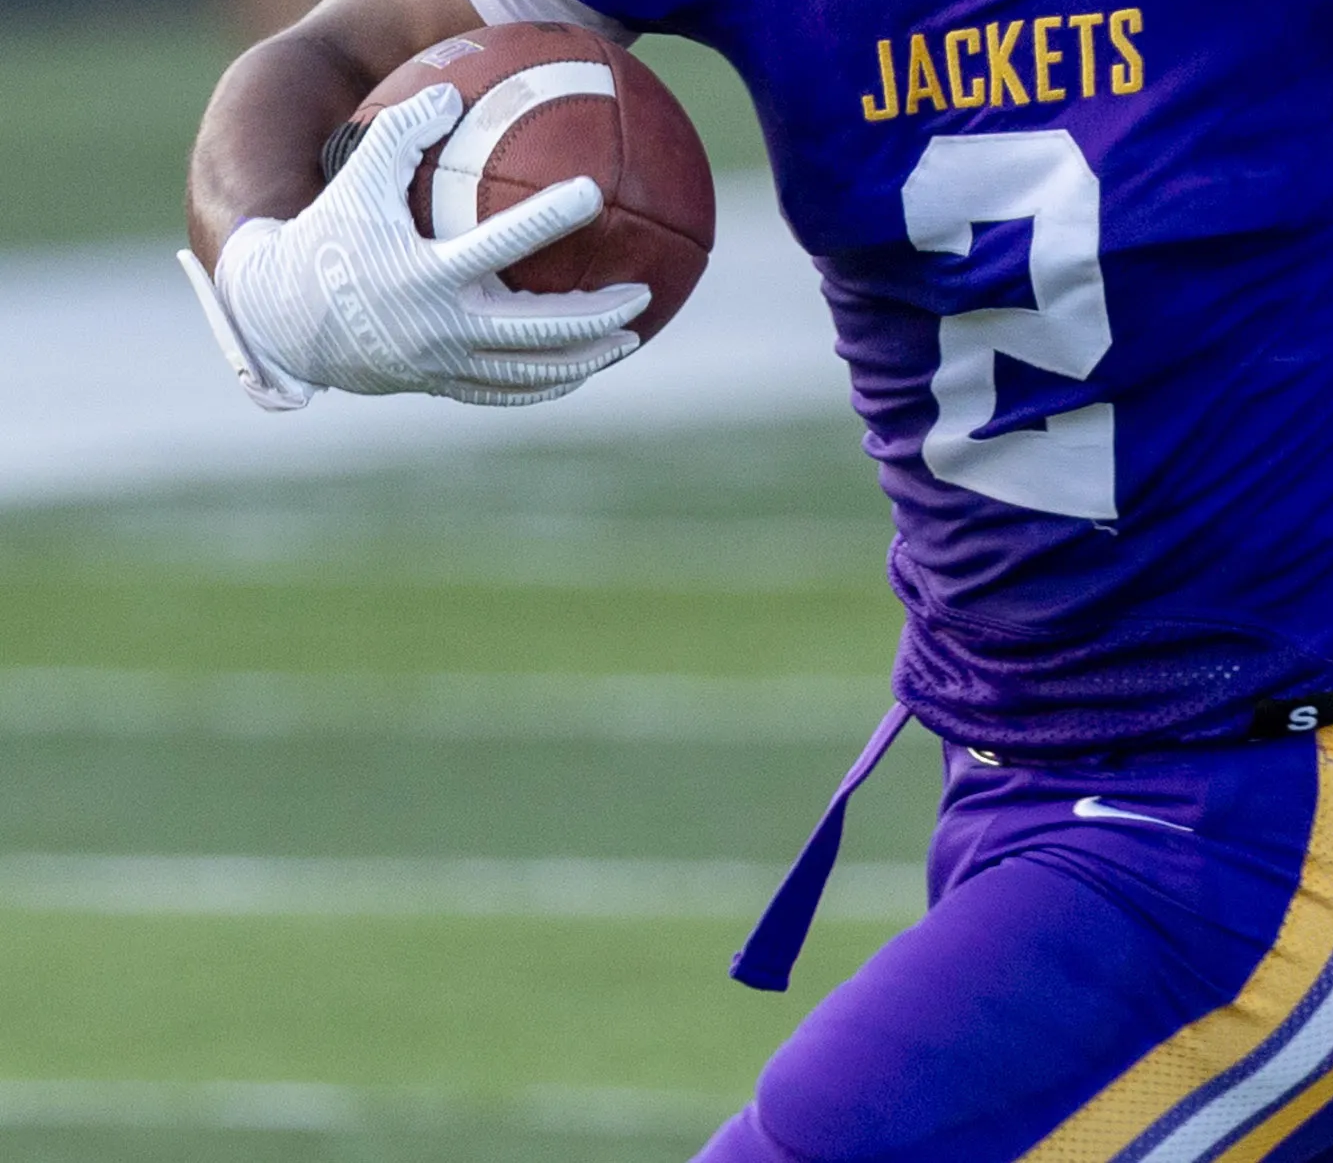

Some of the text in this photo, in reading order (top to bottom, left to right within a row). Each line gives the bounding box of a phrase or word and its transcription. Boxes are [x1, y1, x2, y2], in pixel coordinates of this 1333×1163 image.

[861, 8, 1146, 122] JACKETS
[900, 128, 1119, 520] 2
[1287, 705, 1319, 732] S
